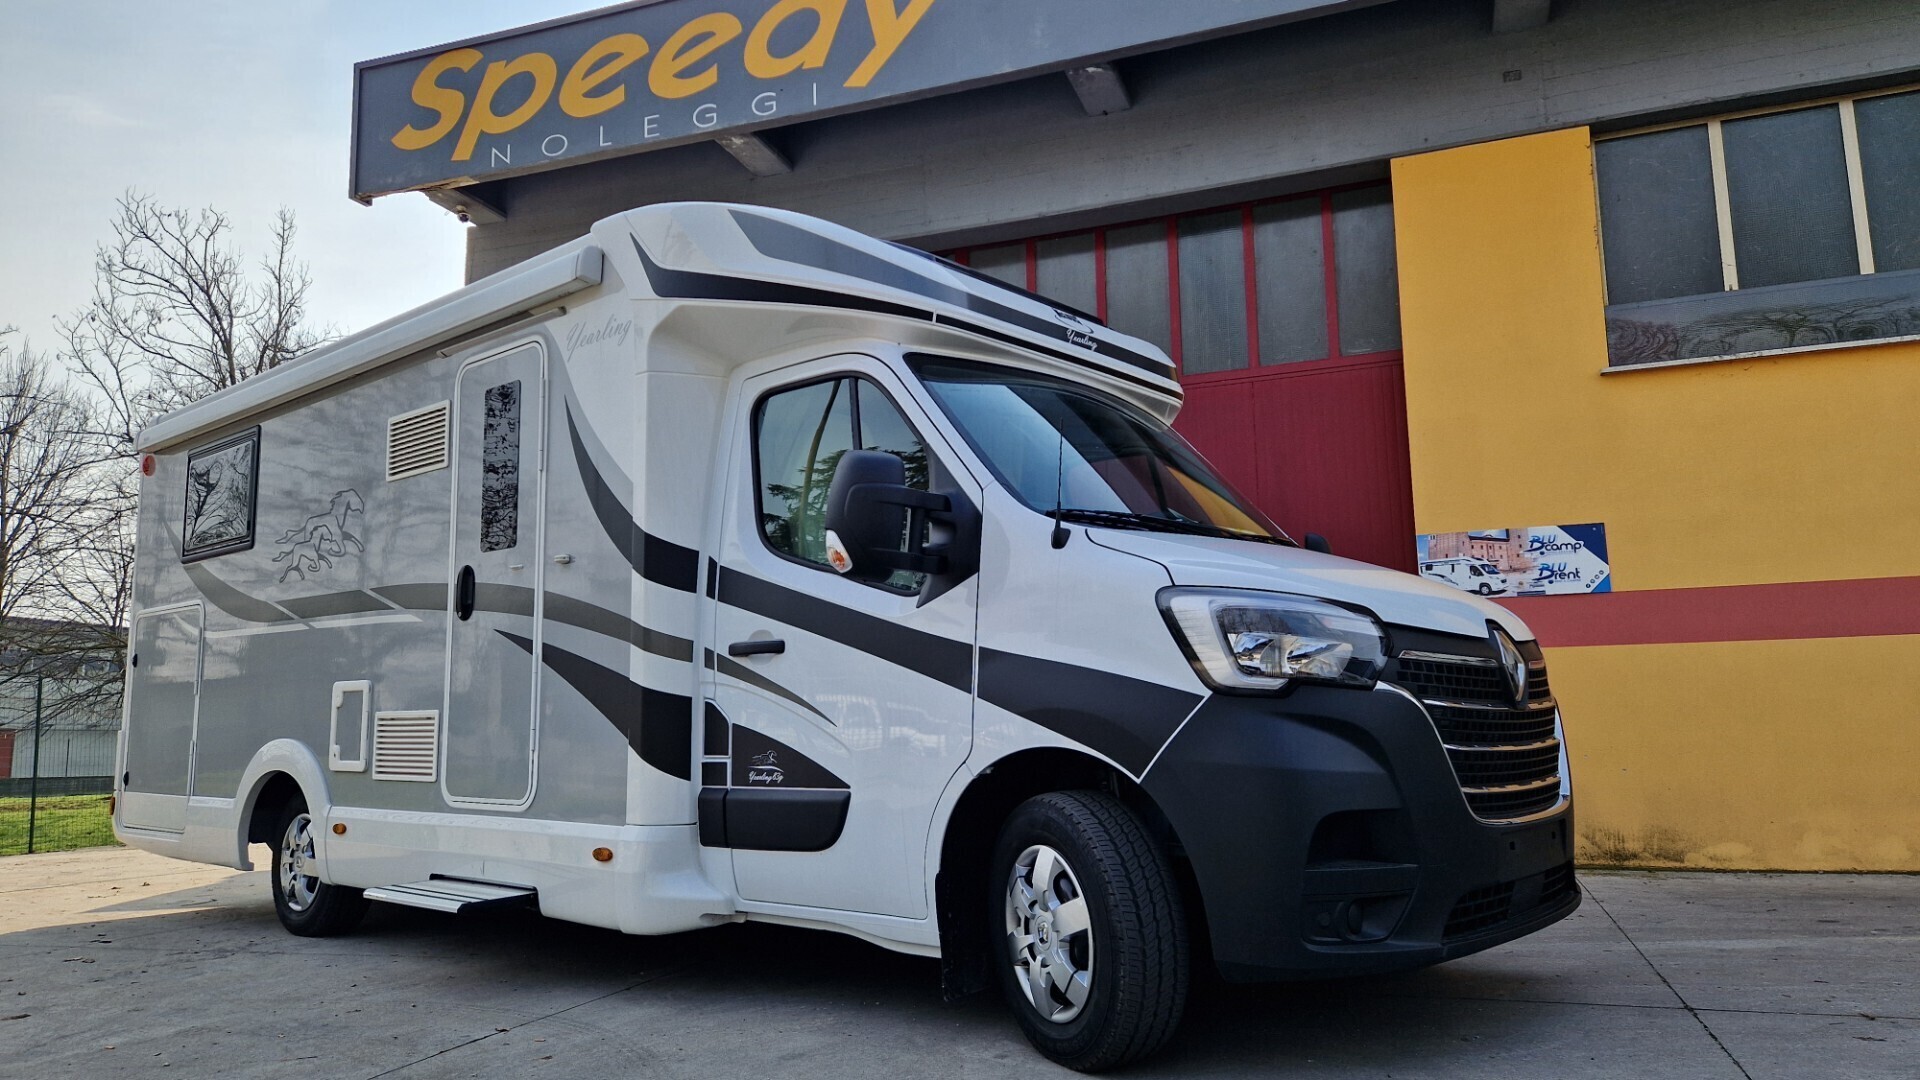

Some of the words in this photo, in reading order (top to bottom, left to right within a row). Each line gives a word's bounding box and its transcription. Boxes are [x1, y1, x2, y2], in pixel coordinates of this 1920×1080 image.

[491, 82, 818, 168] NOLEGGI
[566, 313, 632, 363] Yearling
[1066, 328, 1098, 352] Yearling
[1545, 540, 1582, 553] camp
[1553, 567, 1581, 580] rent
